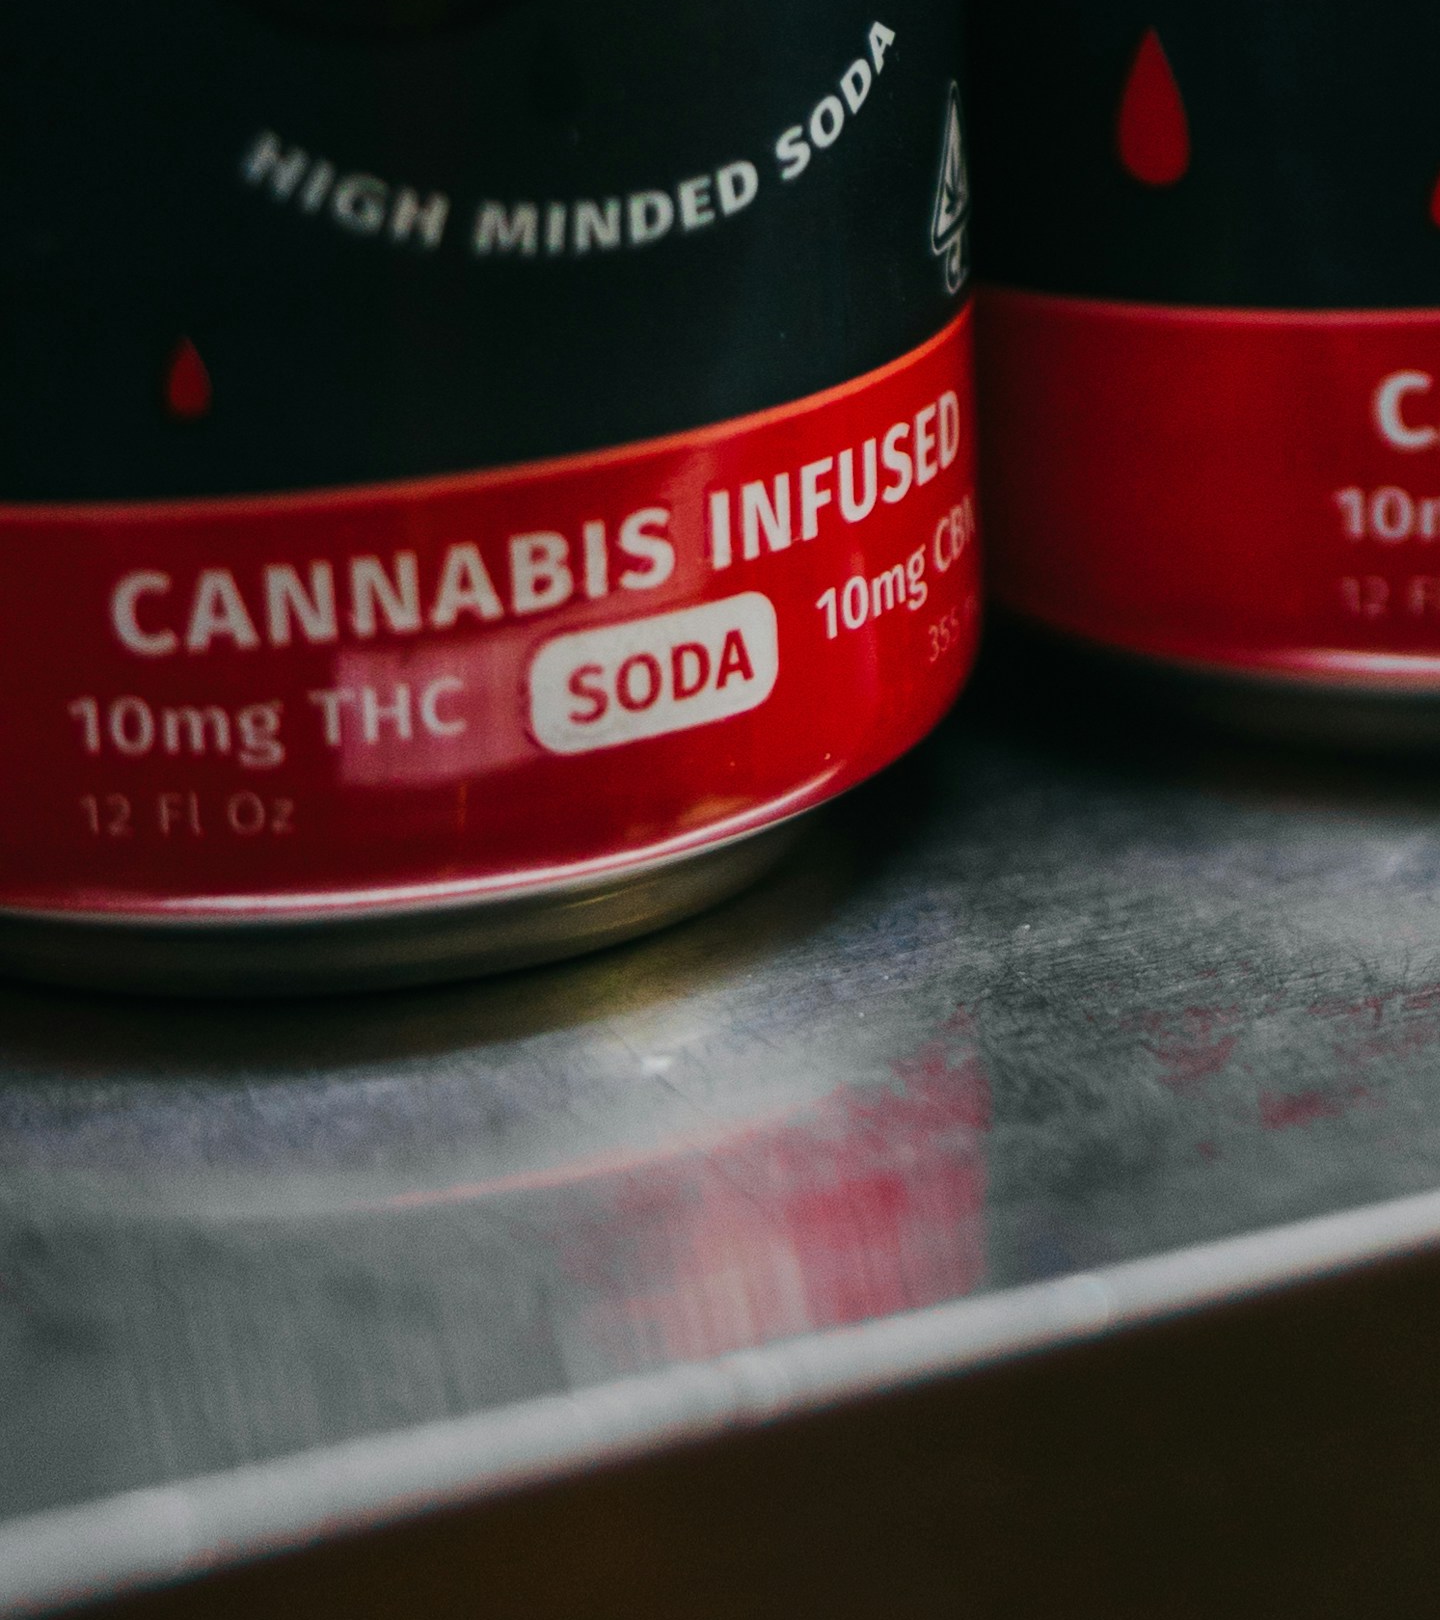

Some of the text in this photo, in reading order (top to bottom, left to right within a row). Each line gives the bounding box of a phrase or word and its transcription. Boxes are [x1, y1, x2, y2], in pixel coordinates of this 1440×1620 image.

[240, 20, 896, 257] HIGH MINDED SODA
[112, 388, 960, 658] CANNABIS INFUSED
[1342, 574, 1390, 616] 12
[68, 692, 284, 765] 10mg
[310, 674, 468, 750] THC
[566, 626, 757, 726] SODA
[815, 543, 928, 640] 10mg
[80, 794, 132, 836] 12
[228, 792, 296, 836] Oz
